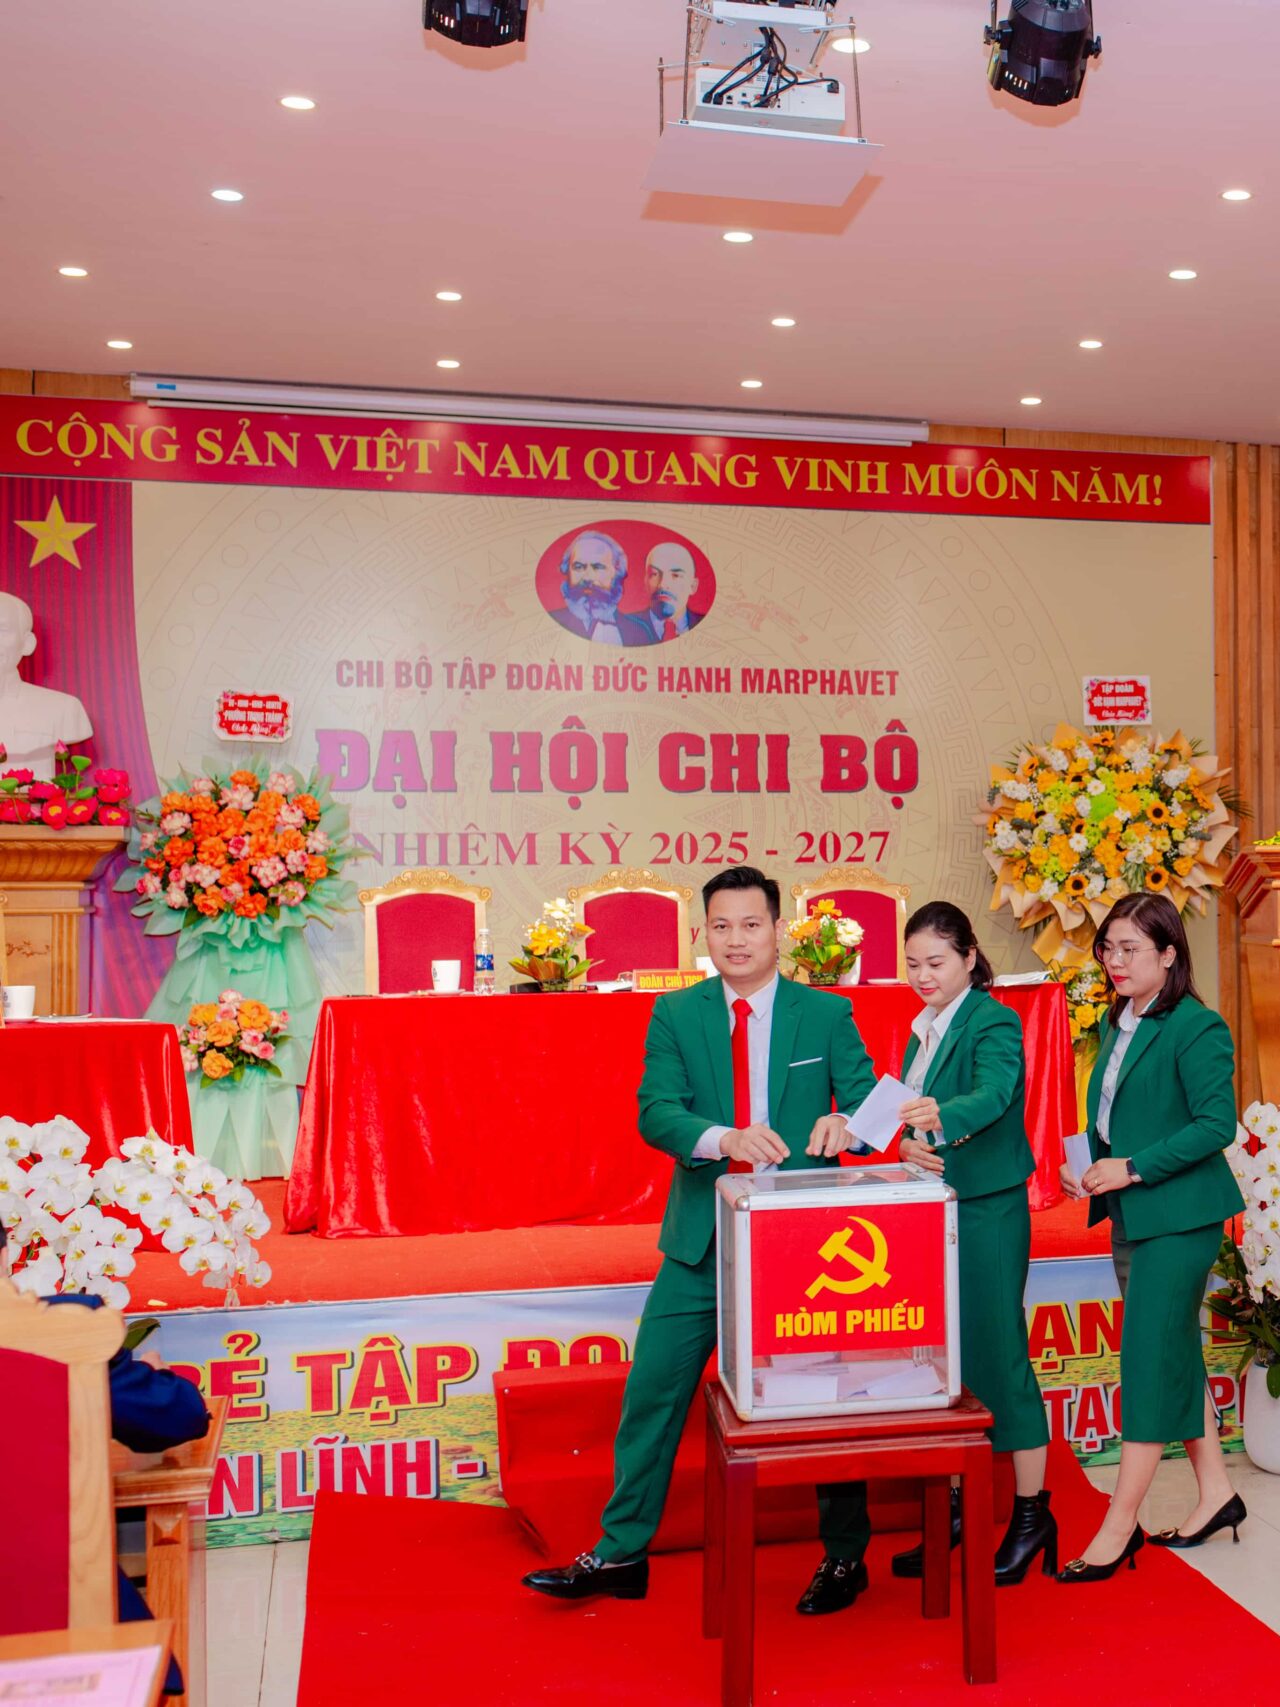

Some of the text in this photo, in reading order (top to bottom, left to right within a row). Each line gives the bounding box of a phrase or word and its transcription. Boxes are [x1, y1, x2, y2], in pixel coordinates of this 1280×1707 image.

[16, 411, 1163, 507] CỘNG SẢN VIỆT NAM QUANG VINH MUÔN NĂM!
[336, 655, 899, 699] CHI BỘ TẬP ĐOÀN ĐỨC HẠNH MARPHAVET
[314, 714, 920, 811] ĐẠI HỘI CHI BỘ
[350, 822, 541, 876] NHIỆM
[557, 822, 633, 866] KỲ
[649, 831, 749, 865] 2025
[795, 831, 890, 864] 2027
[775, 1298, 925, 1338] HÒM PHIẾU
[292, 1333, 479, 1426] TẬP
[276, 1433, 441, 1513] LĨNH
